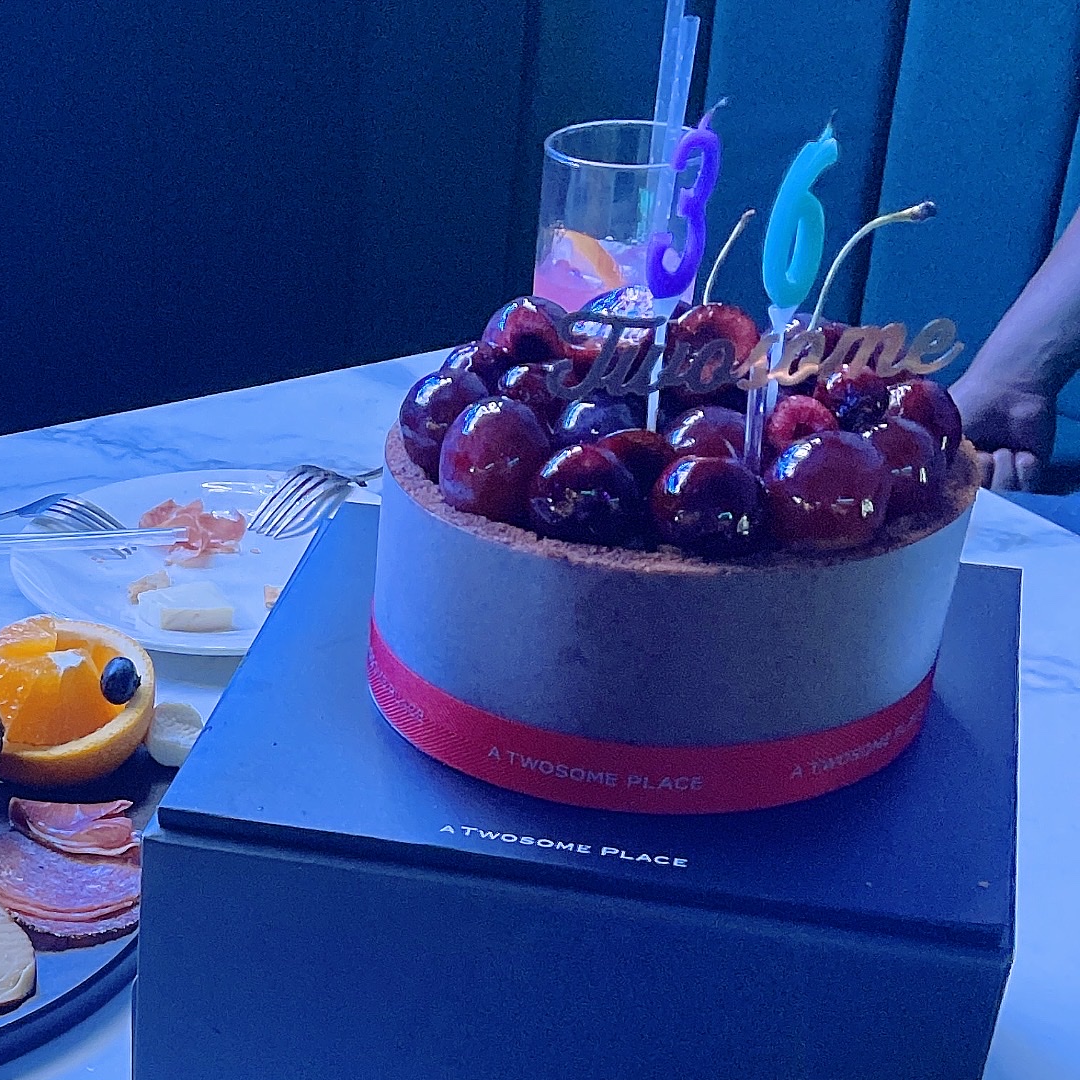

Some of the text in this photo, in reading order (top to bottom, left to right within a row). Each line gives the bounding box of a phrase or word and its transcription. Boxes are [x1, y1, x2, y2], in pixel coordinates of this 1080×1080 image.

[487, 746, 704, 791] A TWOSOME PLACE
[439, 824, 688, 868] A TWOSOME PLACE
